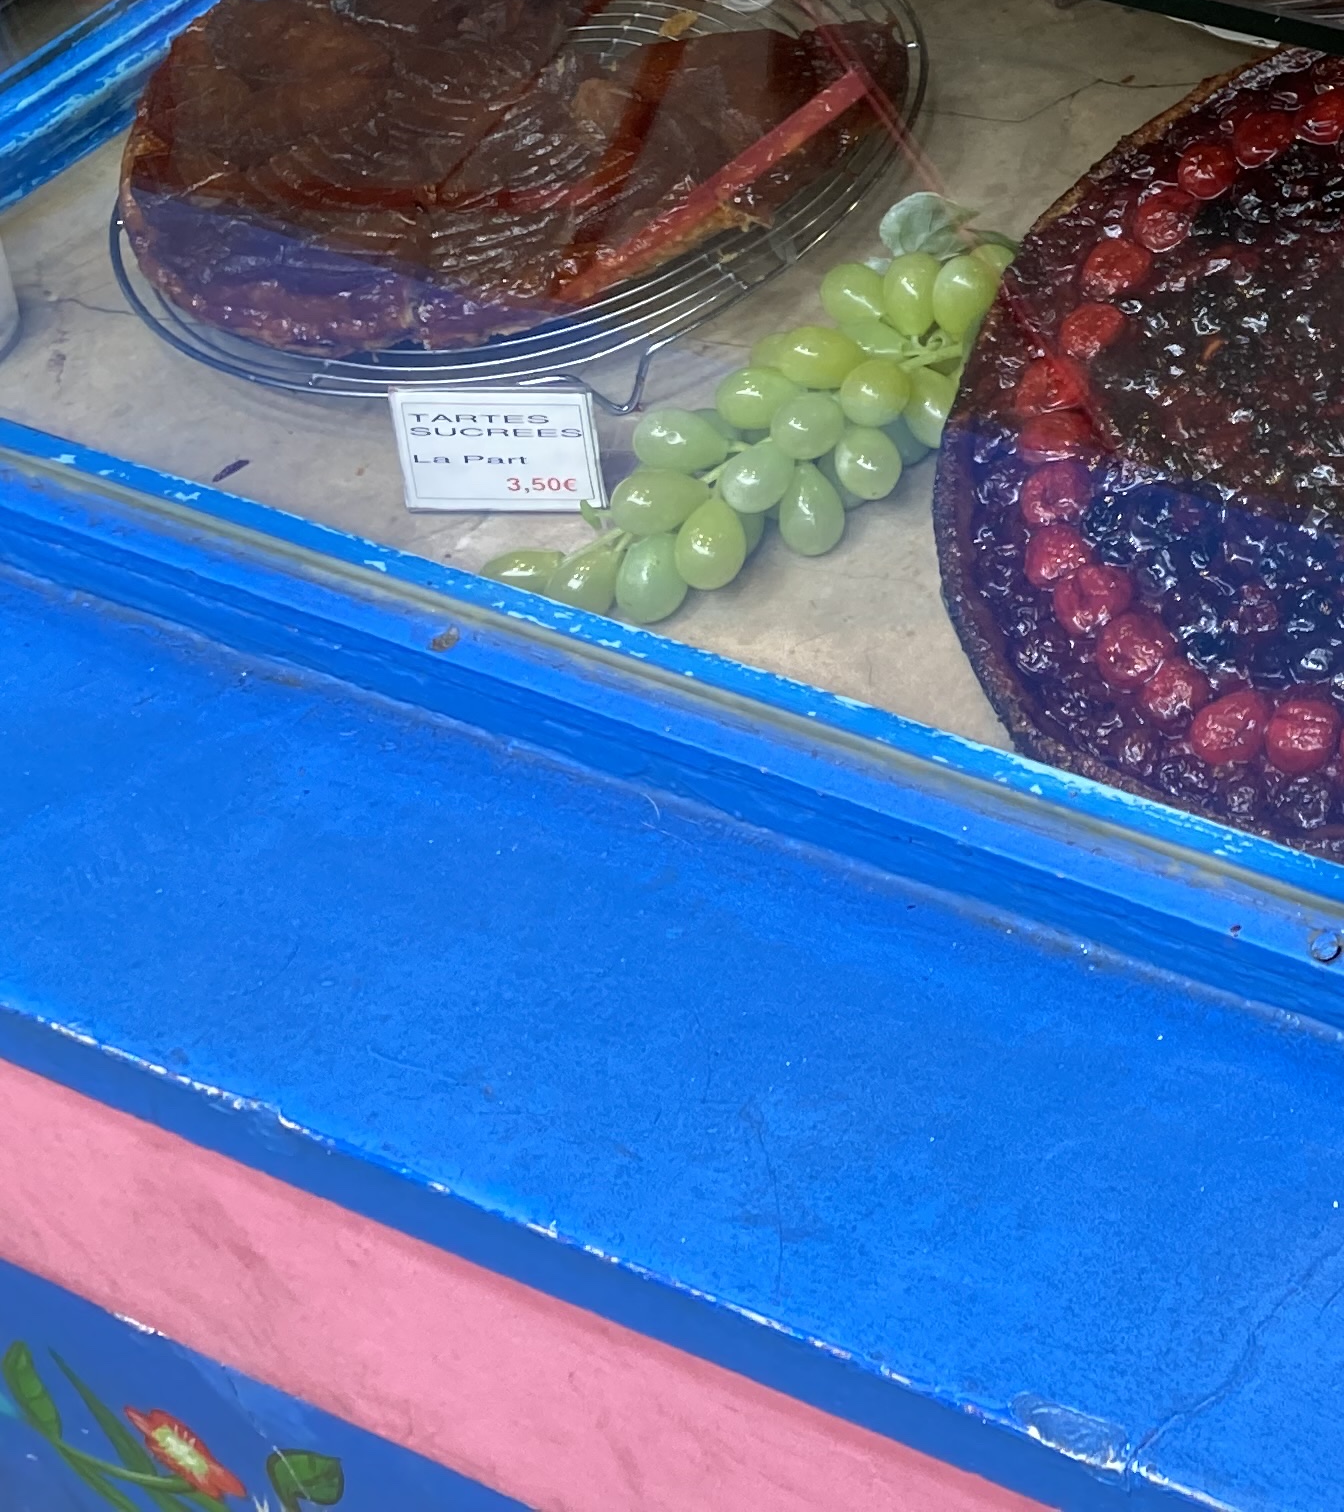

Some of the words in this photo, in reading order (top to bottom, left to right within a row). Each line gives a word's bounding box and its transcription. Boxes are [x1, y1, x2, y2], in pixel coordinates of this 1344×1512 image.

[408, 412, 550, 425] TARTES
[409, 426, 583, 439] SUCREES
[413, 454, 451, 465] La
[463, 454, 529, 465] Part
[505, 476, 578, 494] 3,50€
